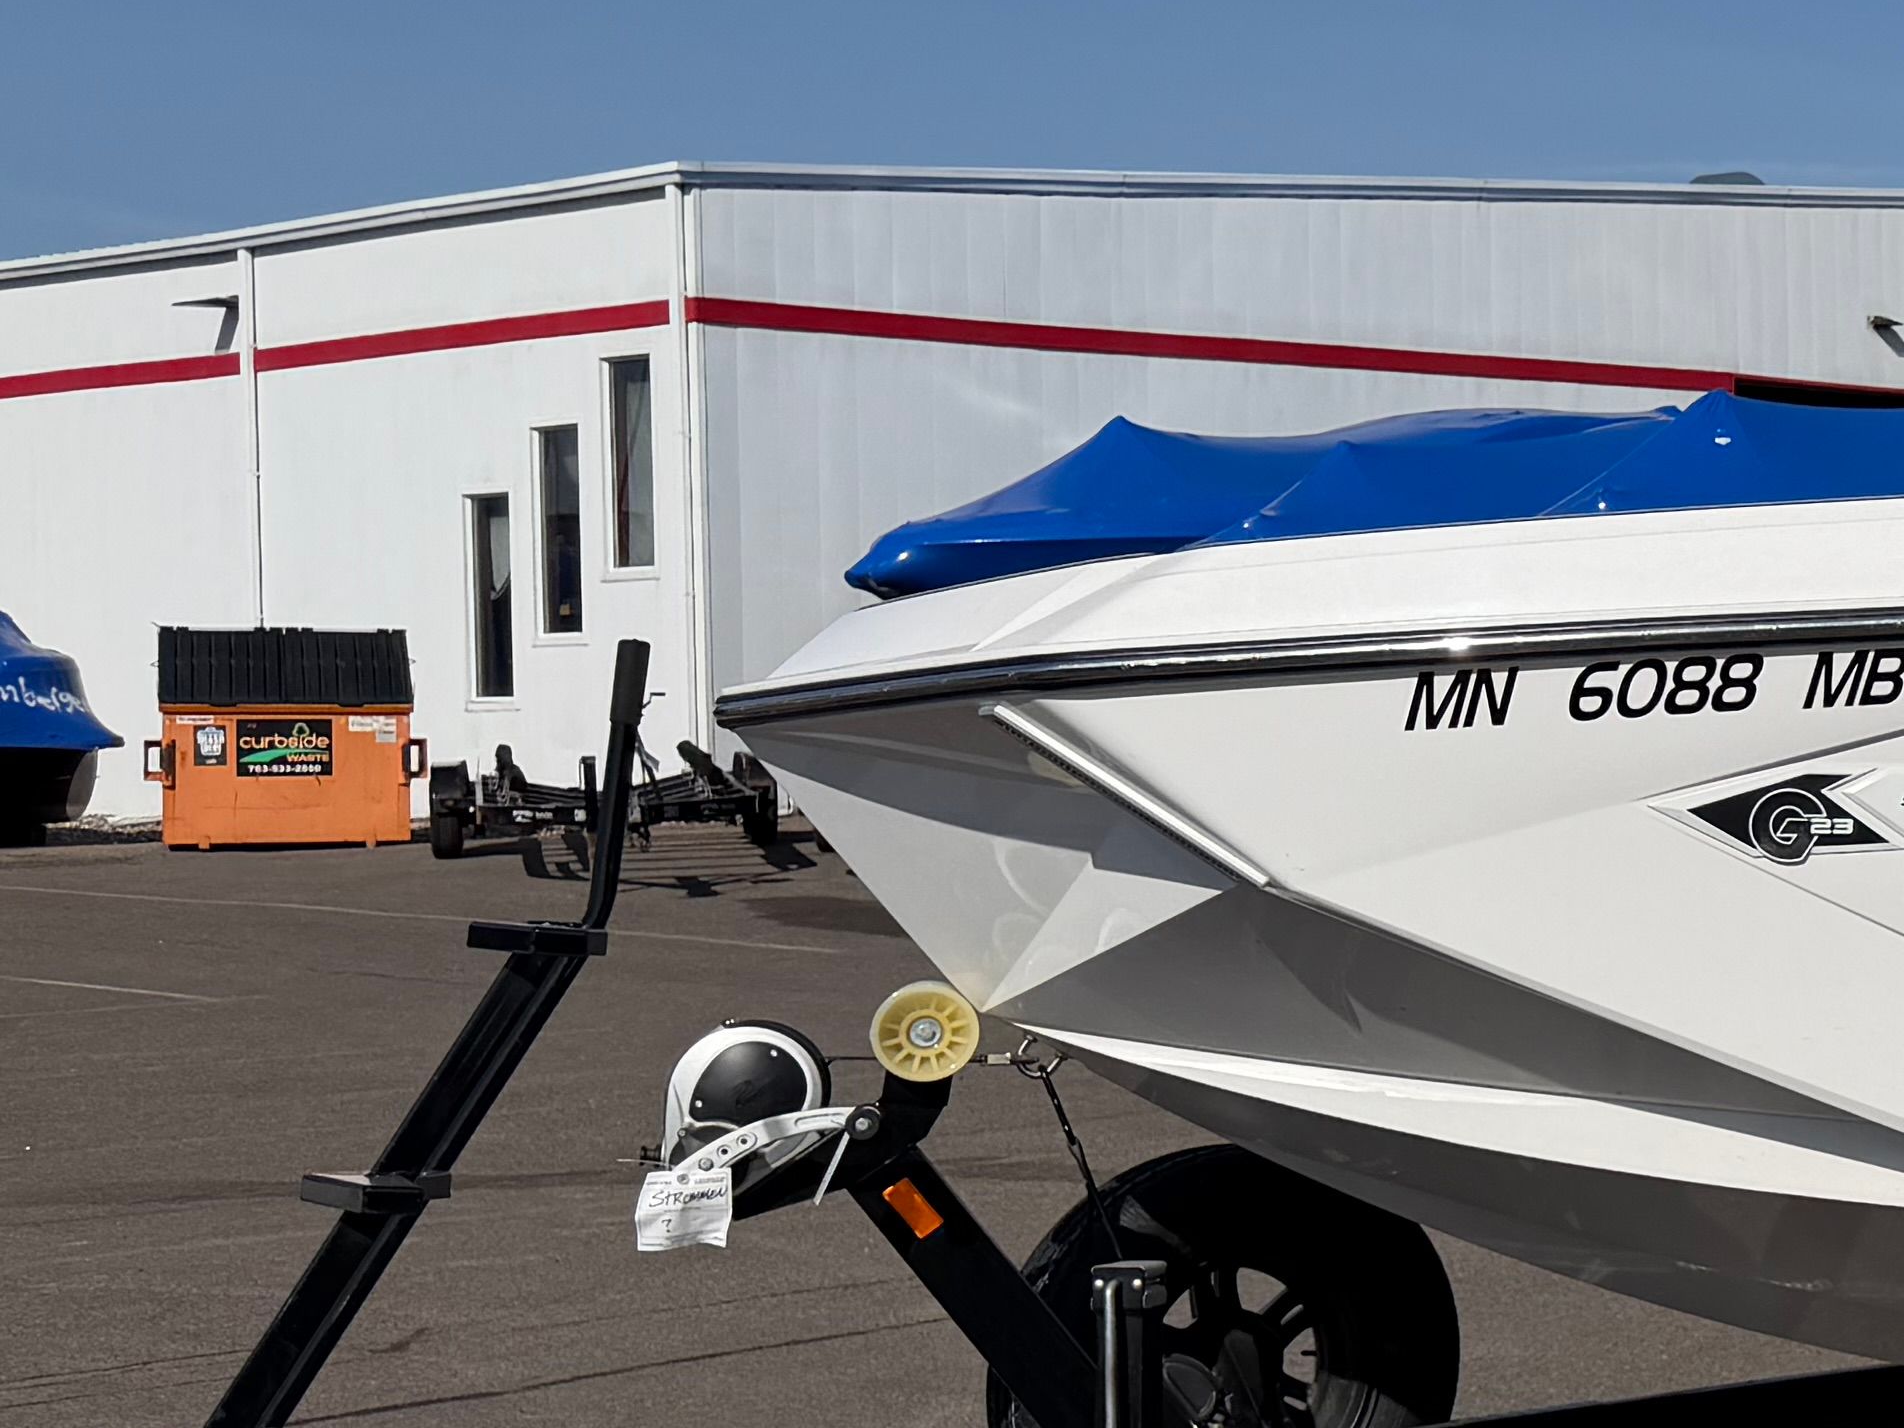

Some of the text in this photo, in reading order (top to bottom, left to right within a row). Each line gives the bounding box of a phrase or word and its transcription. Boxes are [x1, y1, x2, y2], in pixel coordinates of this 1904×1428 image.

[1404, 665, 1520, 732] MN
[1568, 653, 1764, 722] 6088
[239, 733, 330, 749] curbside
